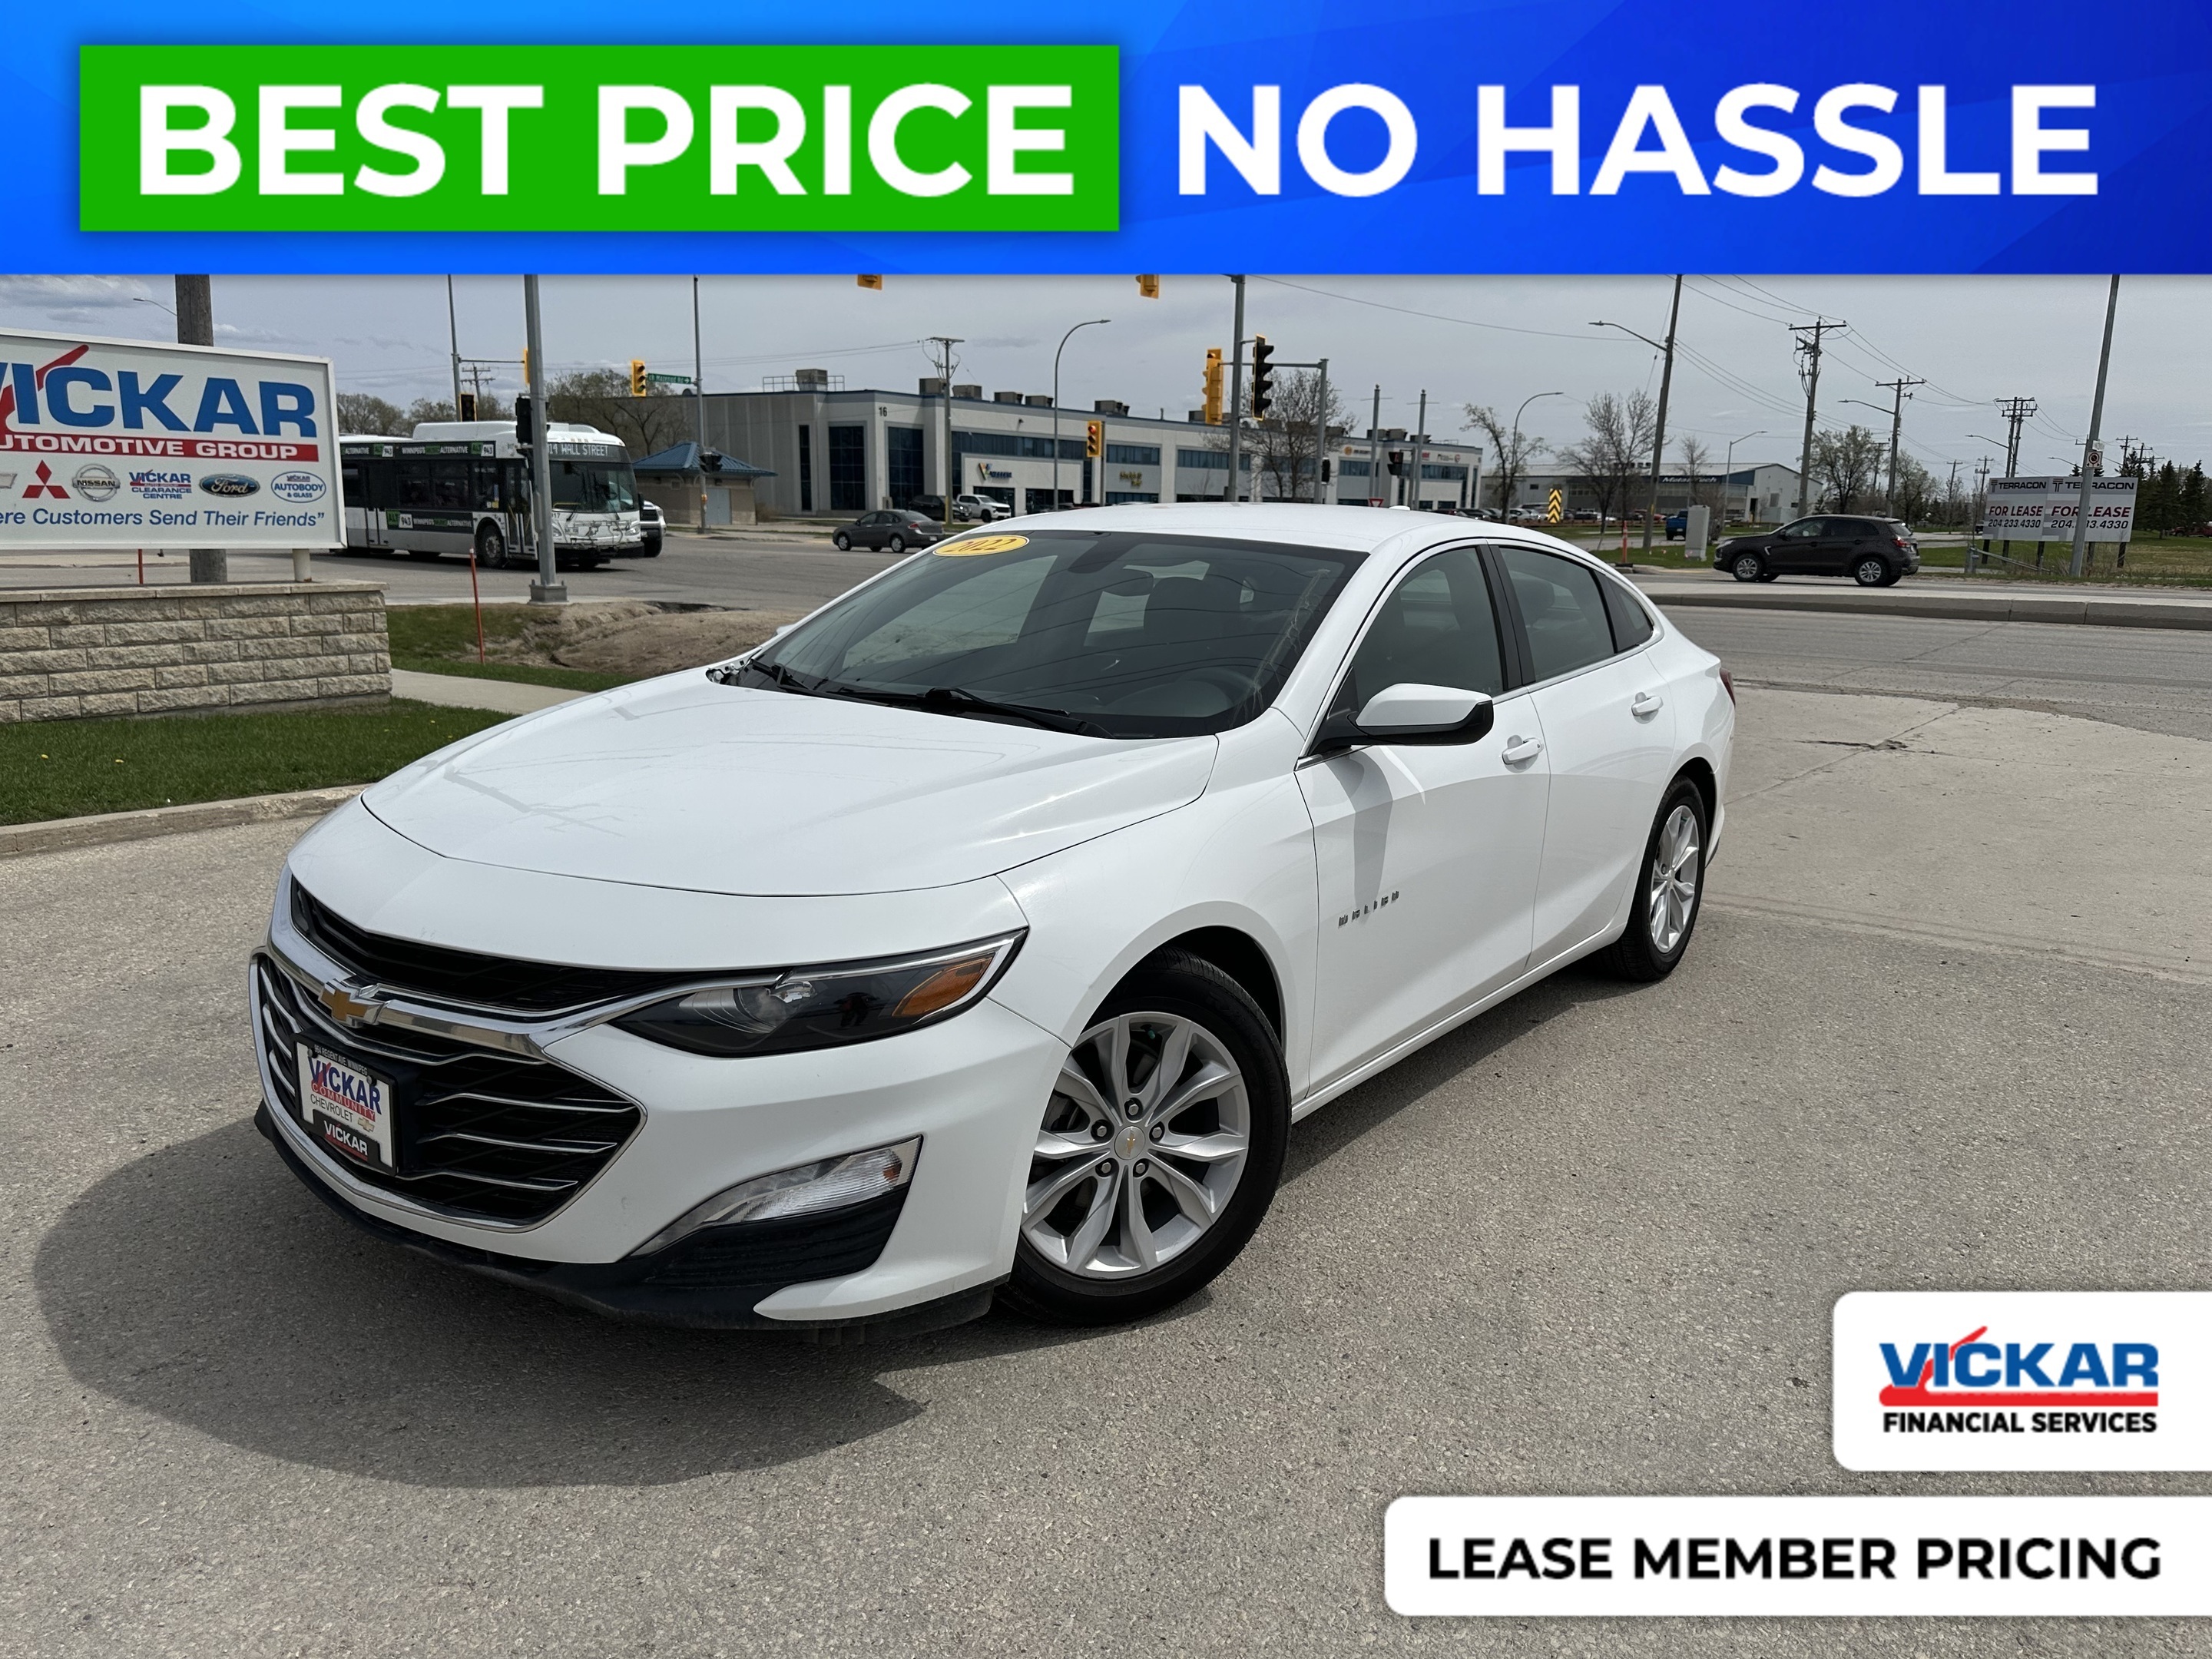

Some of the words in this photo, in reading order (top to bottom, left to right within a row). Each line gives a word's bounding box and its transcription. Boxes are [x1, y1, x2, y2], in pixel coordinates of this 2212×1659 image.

[0, 363, 317, 438] ICKAR
[879, 406, 888, 416] 16
[0, 434, 184, 455] UTOMOTIVE
[196, 442, 298, 459] GROUP
[561, 444, 581, 455] WALL
[583, 444, 608, 456] STREET
[129, 472, 191, 483] VICKAR
[210, 478, 248, 494] Ford
[274, 483, 323, 492] AUTOBODY
[33, 508, 143, 525] Customers
[149, 509, 197, 525] Send
[204, 511, 249, 525] Their
[1989, 505, 2008, 516] FOR
[2010, 505, 2044, 516] LEASE
[1988, 519, 2041, 528] 204.233.4330
[2051, 520, 2129, 528] 204.3.4330
[943, 538, 1017, 553] 2022
[1339, 890, 1399, 927] MALIBU
[308, 1057, 382, 1115] VICKAR
[310, 1094, 353, 1122] CHEVROLET
[313, 1083, 375, 1120] COMMUNITY
[323, 1120, 368, 1156] VICKAR
